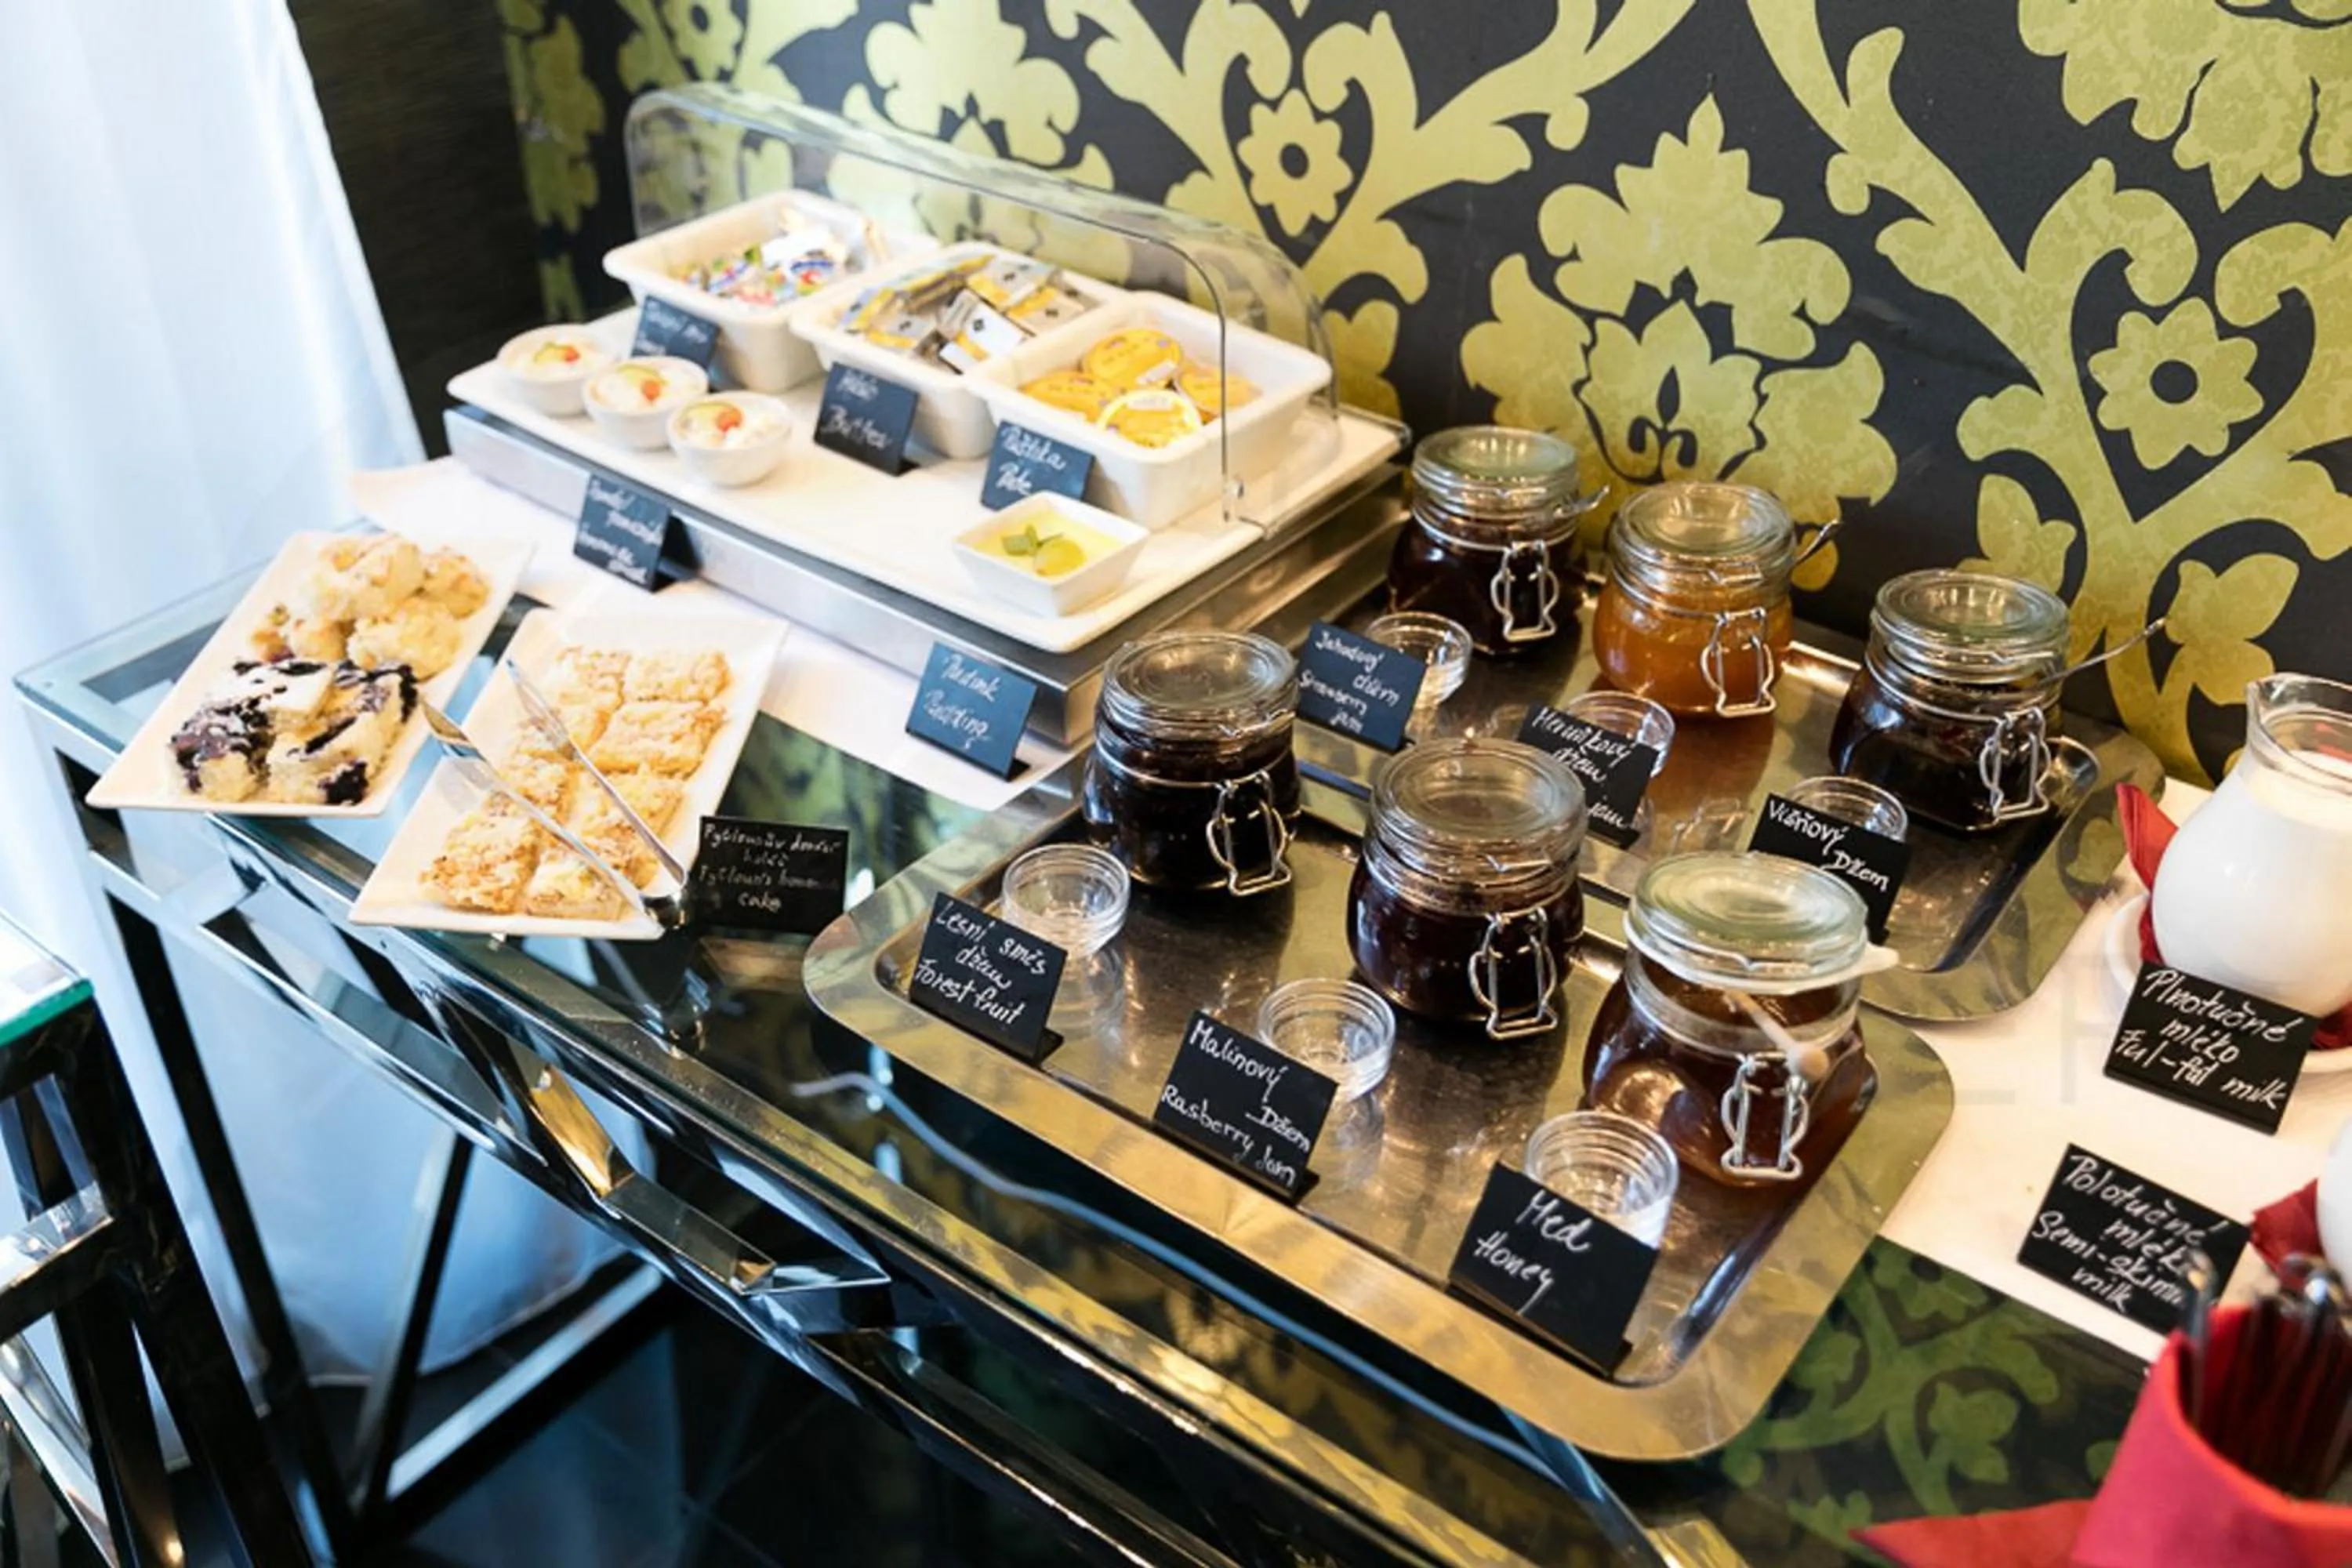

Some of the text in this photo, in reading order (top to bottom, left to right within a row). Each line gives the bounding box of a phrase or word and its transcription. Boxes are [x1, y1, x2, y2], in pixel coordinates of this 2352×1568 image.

[974, 985, 1025, 1025] fruit
[1189, 1018, 1290, 1105] Malinový
[2220, 1076, 2288, 1110] milk
[1514, 1189, 1593, 1253] Med
[2100, 1218, 2193, 1276] mlék
[1474, 1229, 1555, 1317] Honey
[2071, 1265, 2134, 1315] milk
